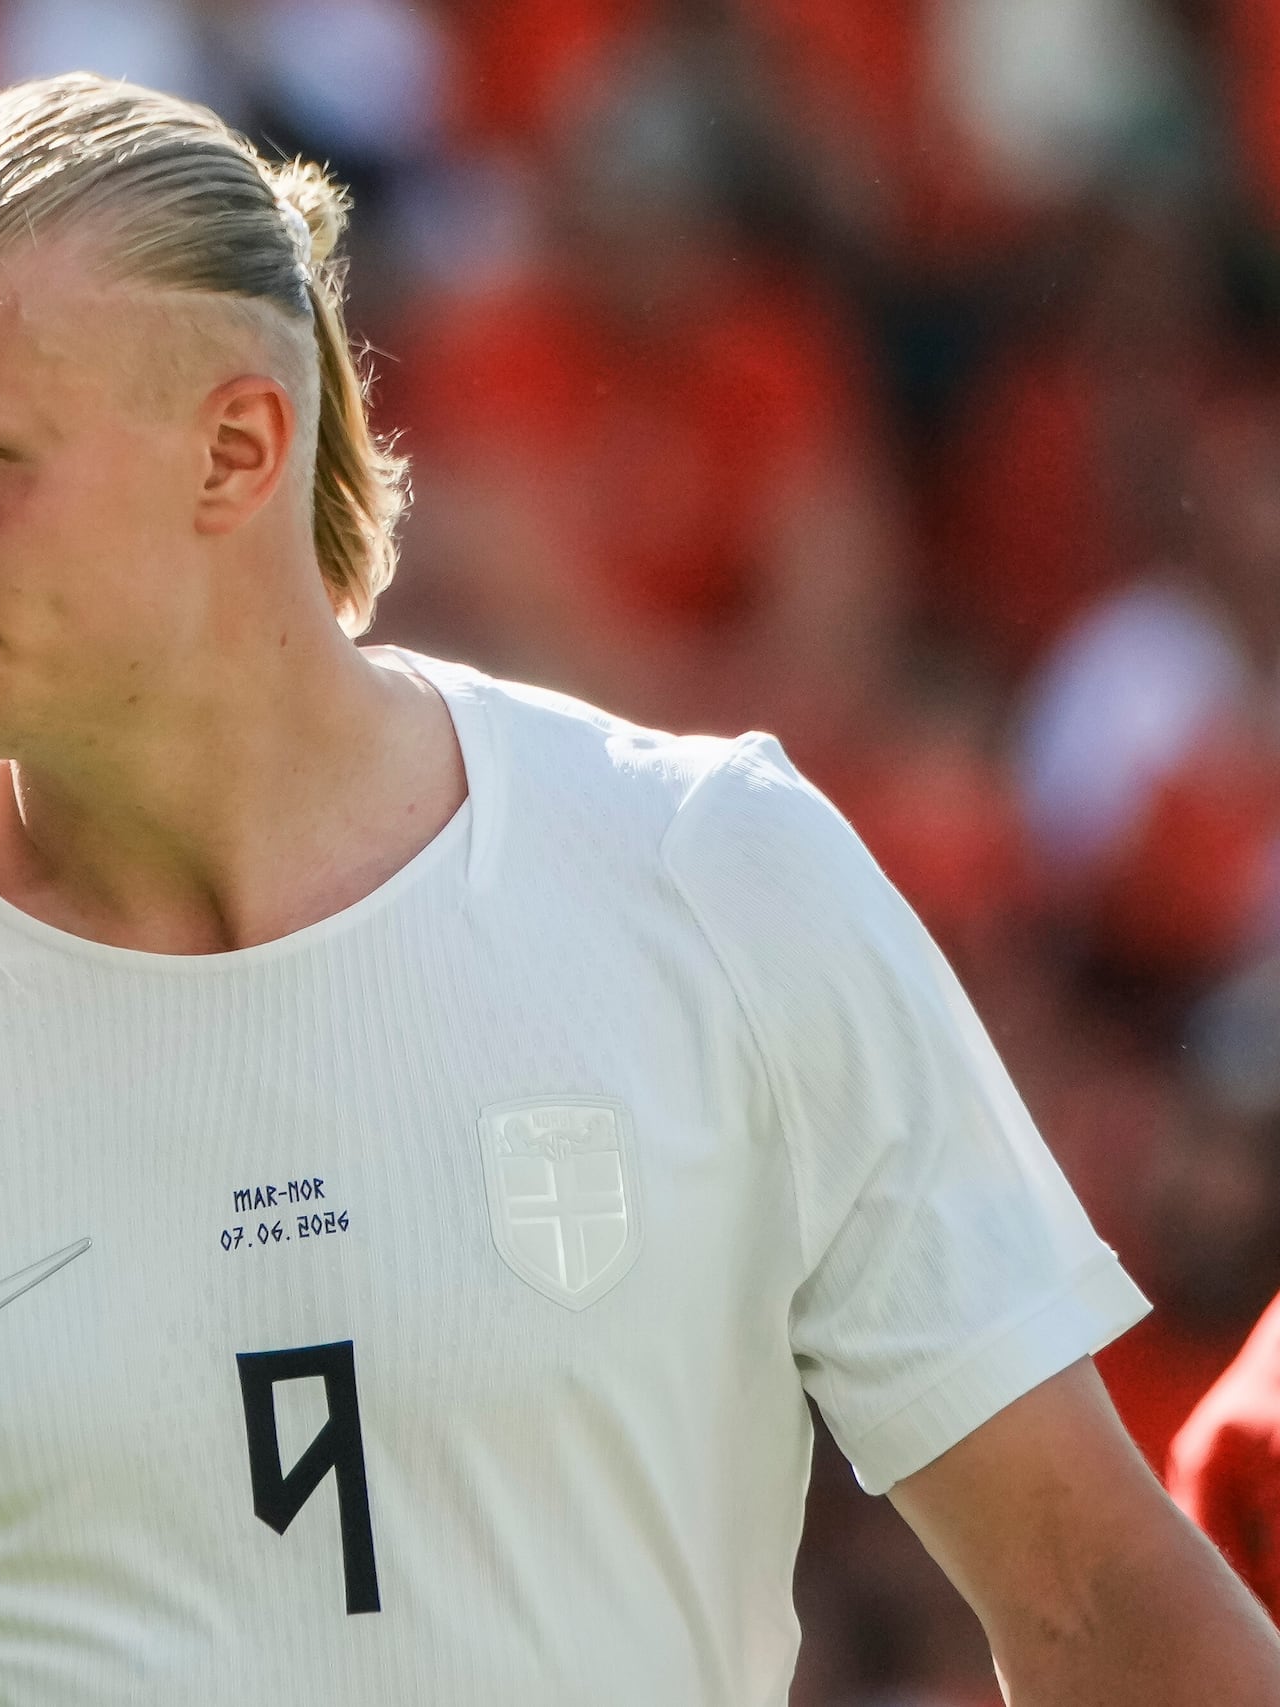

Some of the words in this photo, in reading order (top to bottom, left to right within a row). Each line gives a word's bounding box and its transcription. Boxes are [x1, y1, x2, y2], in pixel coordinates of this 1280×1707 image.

[233, 1178, 325, 1212] MAR-NOR
[220, 1210, 349, 1251] 07.06.2026
[235, 1340, 381, 1616] 9
